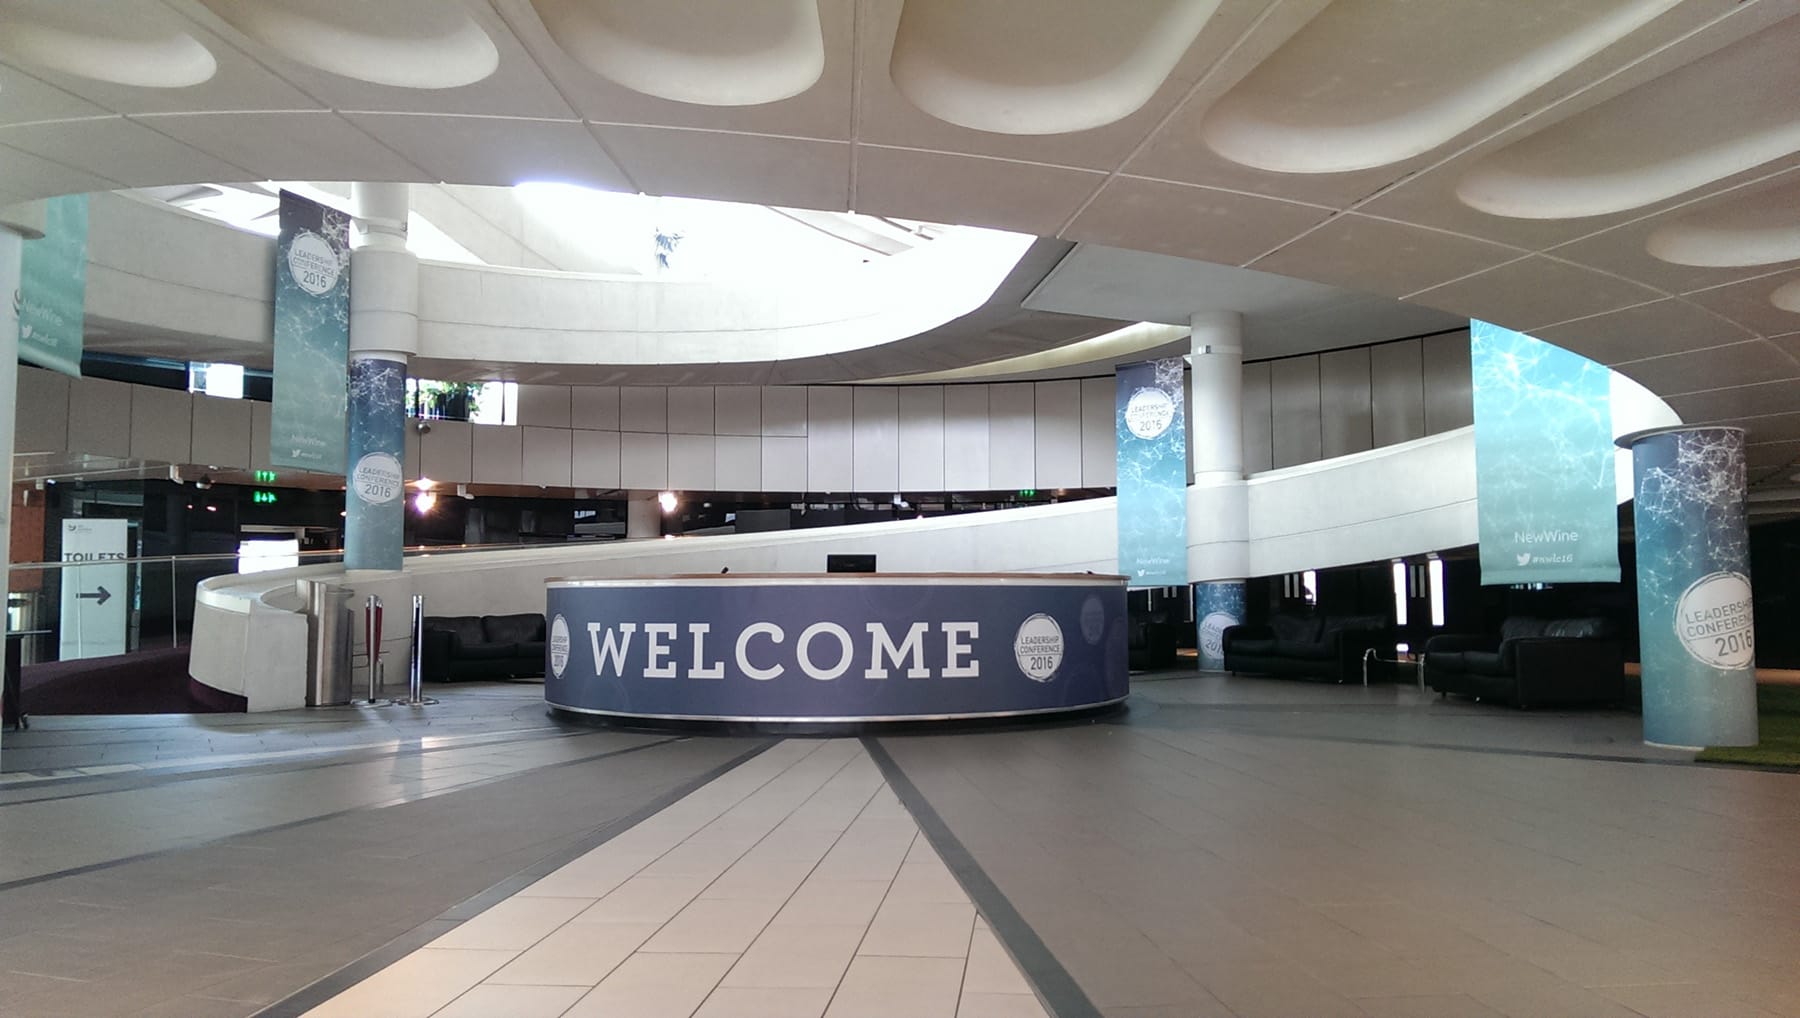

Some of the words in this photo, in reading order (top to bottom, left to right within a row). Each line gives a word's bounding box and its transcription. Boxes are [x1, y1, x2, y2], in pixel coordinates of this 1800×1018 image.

[303, 270, 327, 288] 2016
[1131, 402, 1168, 414] LEADERS
[1139, 419, 1162, 432] 2016
[365, 484, 391, 498] 2016
[1513, 529, 1579, 544] NewWine
[1685, 597, 1752, 625] LEADERSH
[1686, 612, 1751, 638] CONFEREN
[1021, 635, 1060, 645] LEADERSHIP
[1206, 638, 1222, 654] 201
[1715, 629, 1753, 657] 2016
[587, 621, 980, 681] WELCOME
[1020, 644, 1061, 654] CONFERENCE
[1030, 656, 1054, 671] 2016
